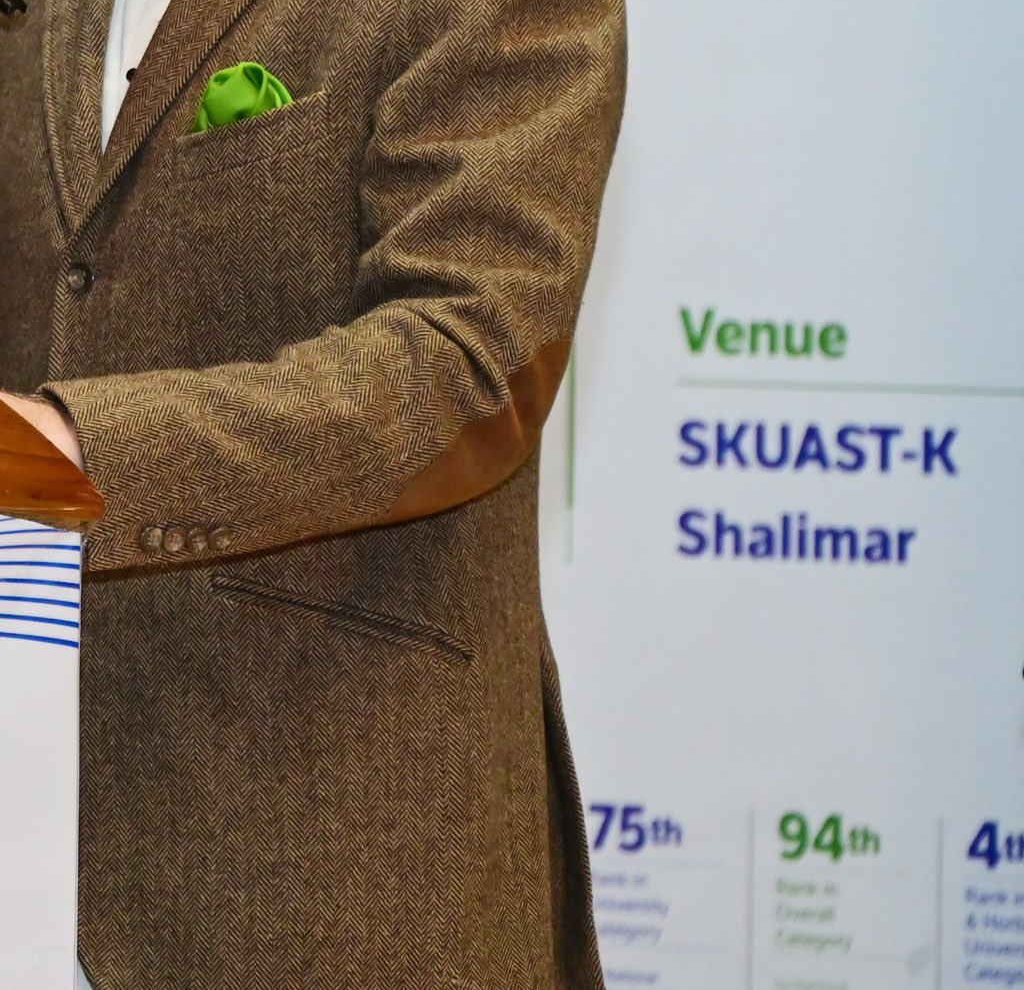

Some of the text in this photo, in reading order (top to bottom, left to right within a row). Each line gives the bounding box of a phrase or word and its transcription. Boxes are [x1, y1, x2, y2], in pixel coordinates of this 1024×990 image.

[680, 307, 848, 358] Venue
[678, 421, 958, 476] SKUAST-K
[677, 510, 916, 564] Shalimar
[590, 804, 682, 852] 75th
[778, 812, 880, 862] 94th
